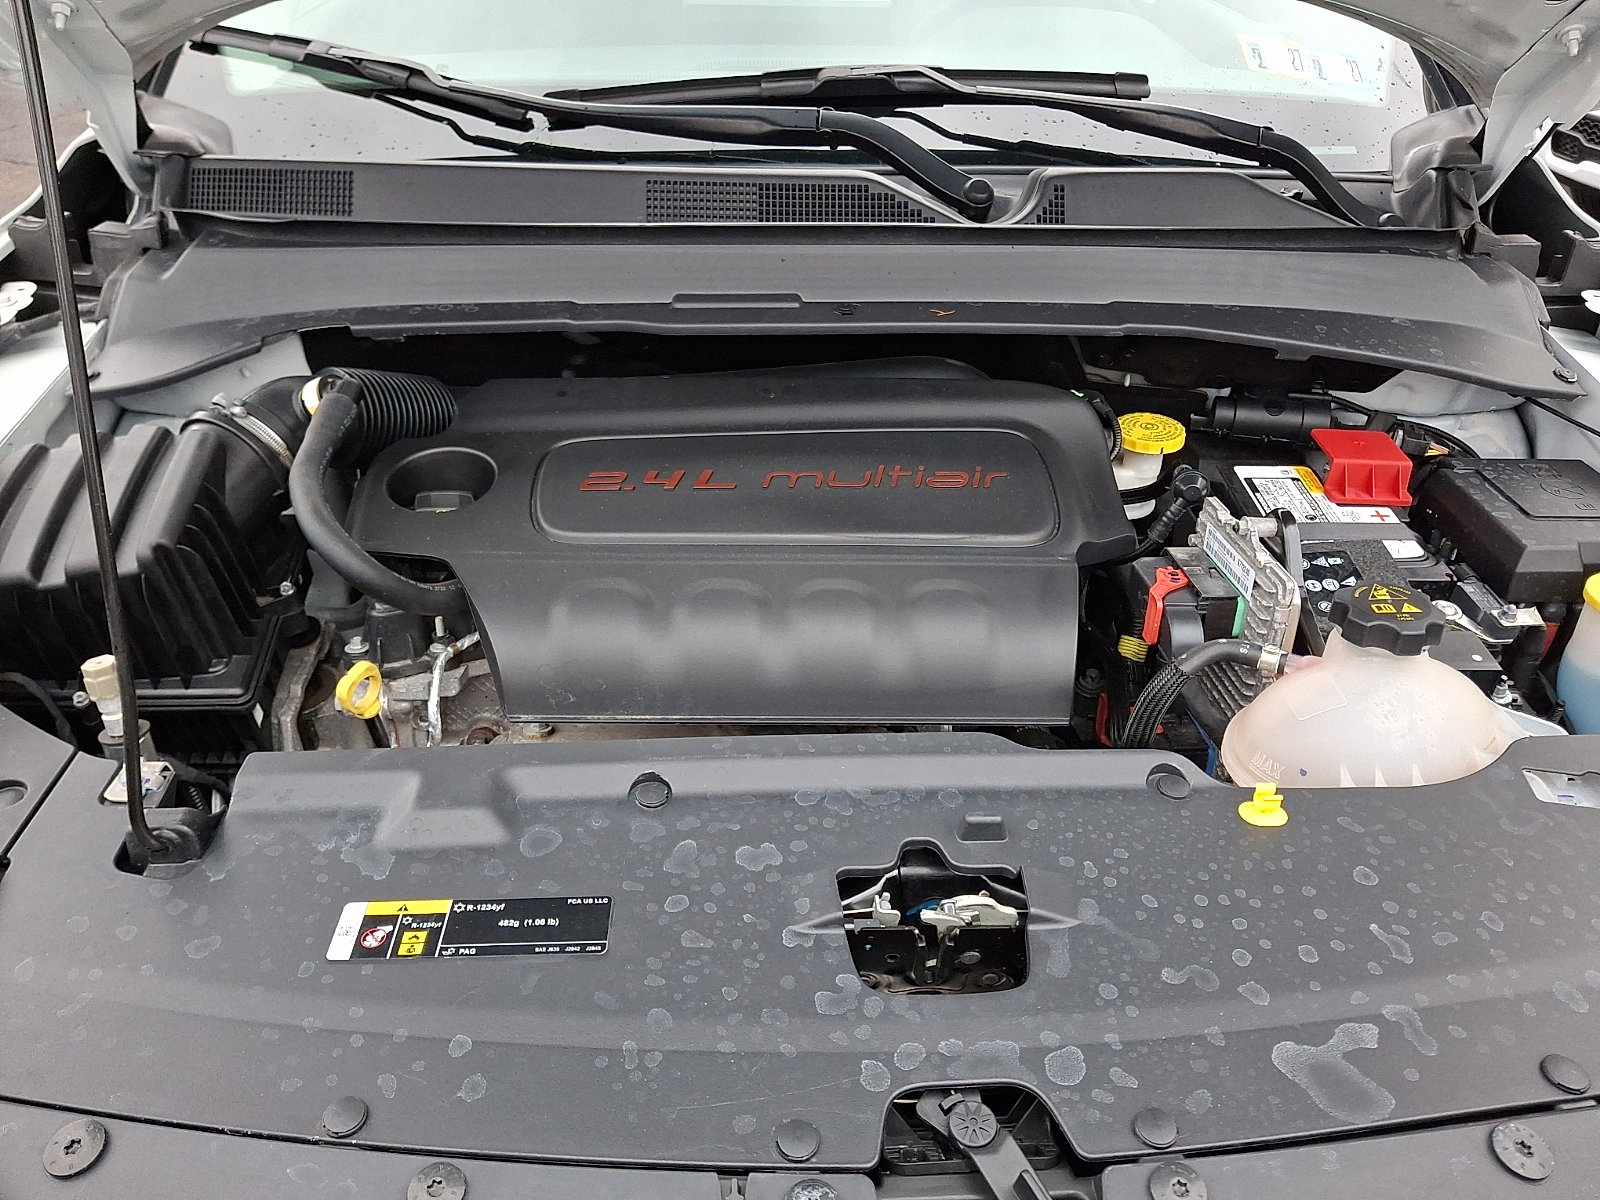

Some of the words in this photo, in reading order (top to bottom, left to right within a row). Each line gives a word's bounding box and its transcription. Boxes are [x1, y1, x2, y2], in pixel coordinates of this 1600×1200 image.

[761, 464, 1010, 489] multiair
[567, 897, 582, 905] FCA
[465, 902, 506, 913] R-1234yf
[458, 947, 477, 956] PAG
